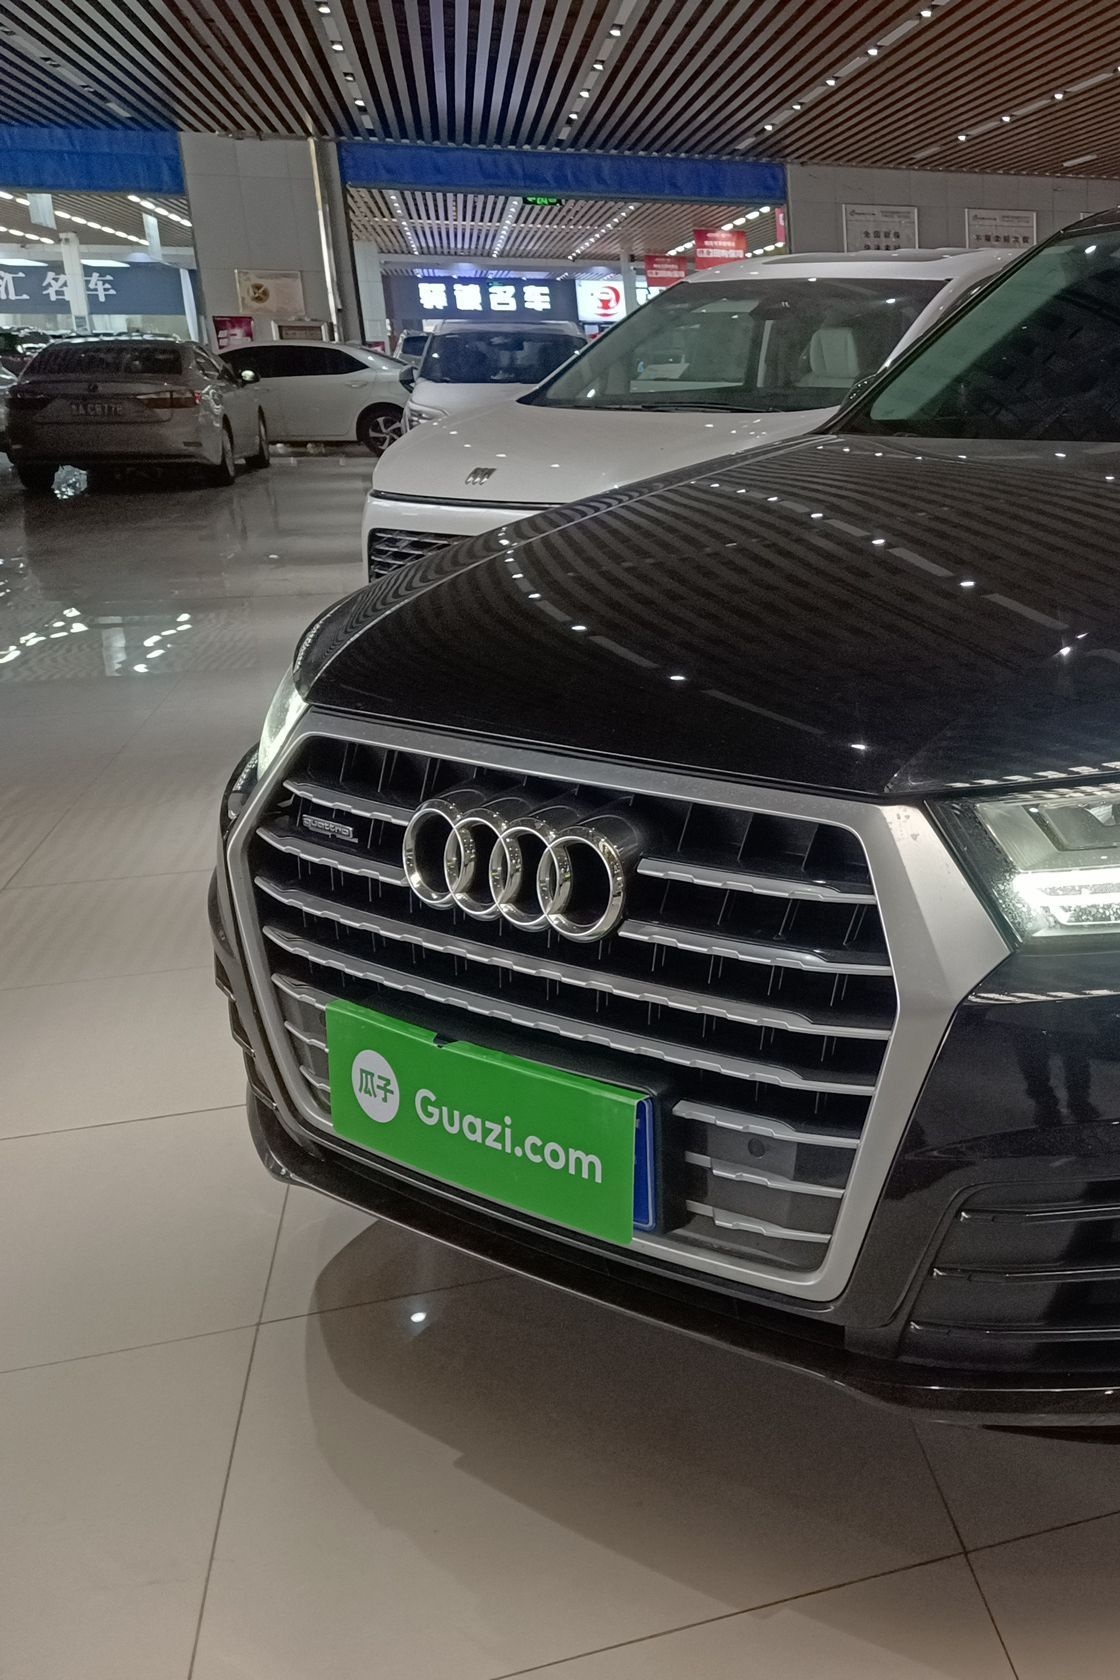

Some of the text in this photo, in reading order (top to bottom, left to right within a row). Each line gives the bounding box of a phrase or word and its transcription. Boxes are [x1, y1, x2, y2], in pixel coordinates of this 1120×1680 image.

[303, 818, 350, 836] quattro
[358, 1067, 394, 1103] 瓜子
[414, 1088, 603, 1184] Guazi.com
